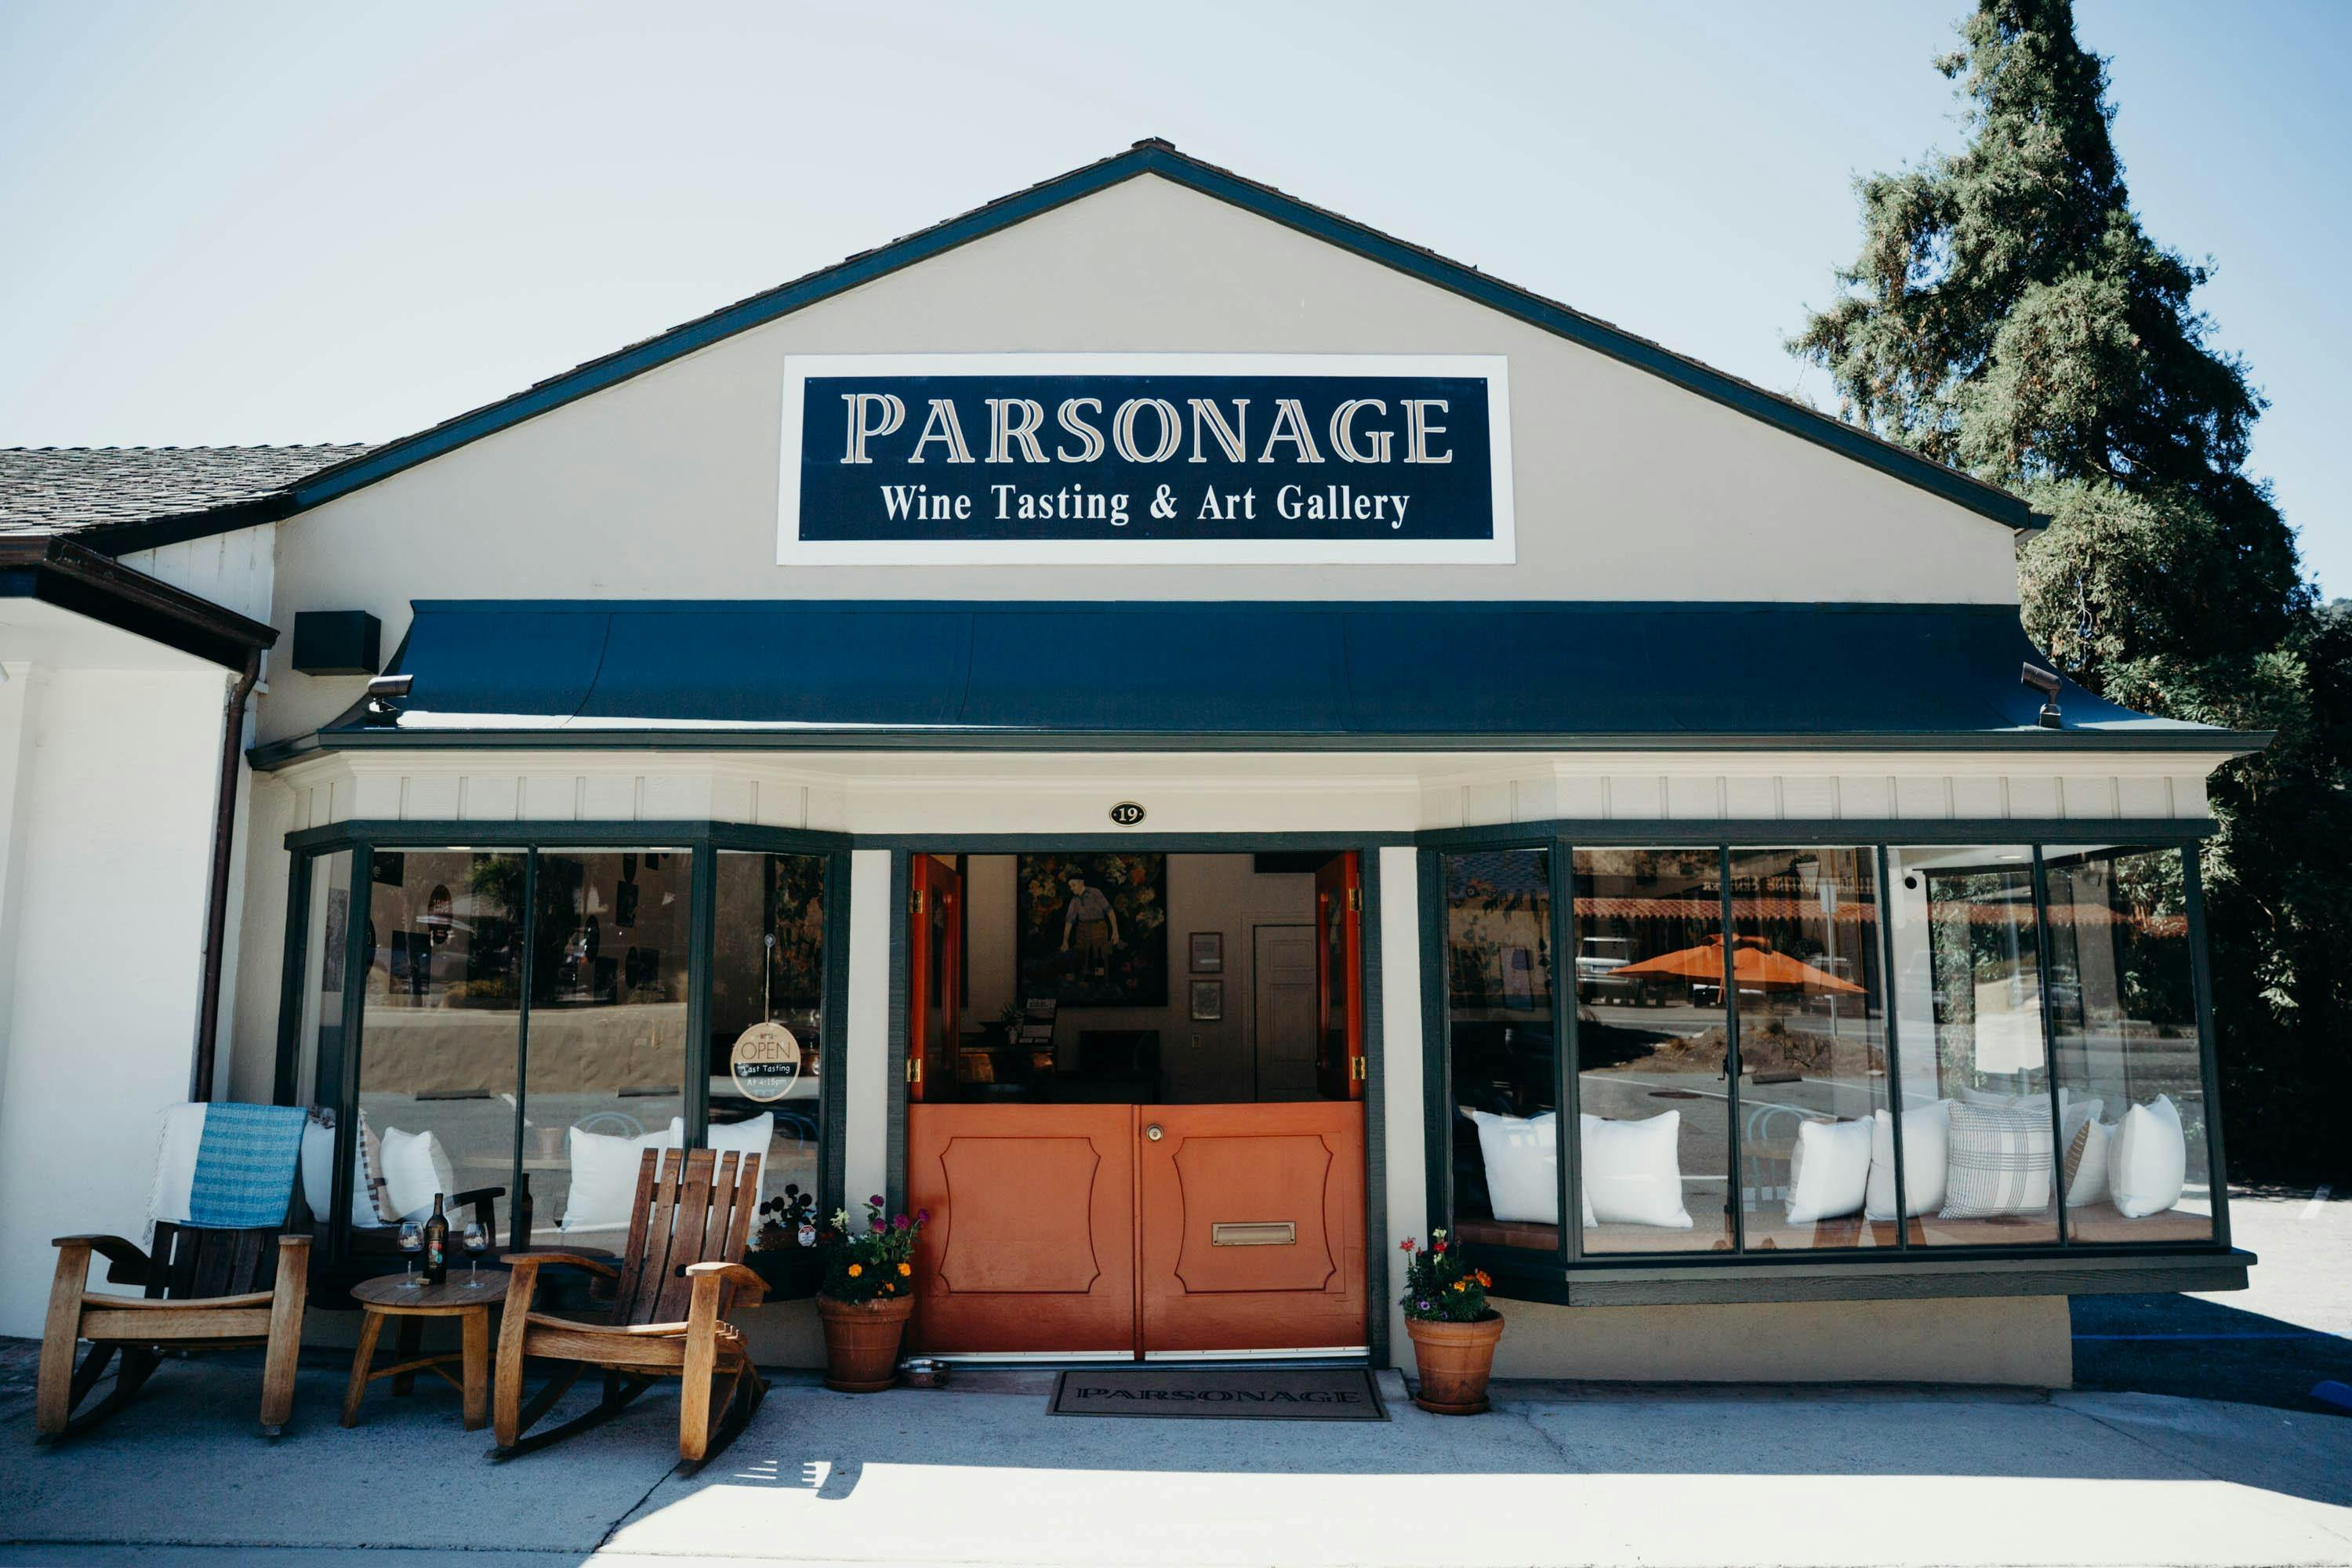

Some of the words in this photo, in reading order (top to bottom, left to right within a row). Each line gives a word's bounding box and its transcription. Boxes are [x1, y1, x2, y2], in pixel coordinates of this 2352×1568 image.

[840, 394, 1454, 464] PARSONAGE
[880, 485, 971, 521] Wine
[991, 484, 1129, 528] Tasting
[1149, 485, 1178, 521] &
[1196, 485, 1256, 521] Art
[1276, 485, 1411, 530] Gallery
[1119, 808, 1138, 822] 19
[741, 1042, 791, 1060] OPEN
[762, 1064, 790, 1074] Tasting
[1076, 1388, 1363, 1403] PARSONAGE
